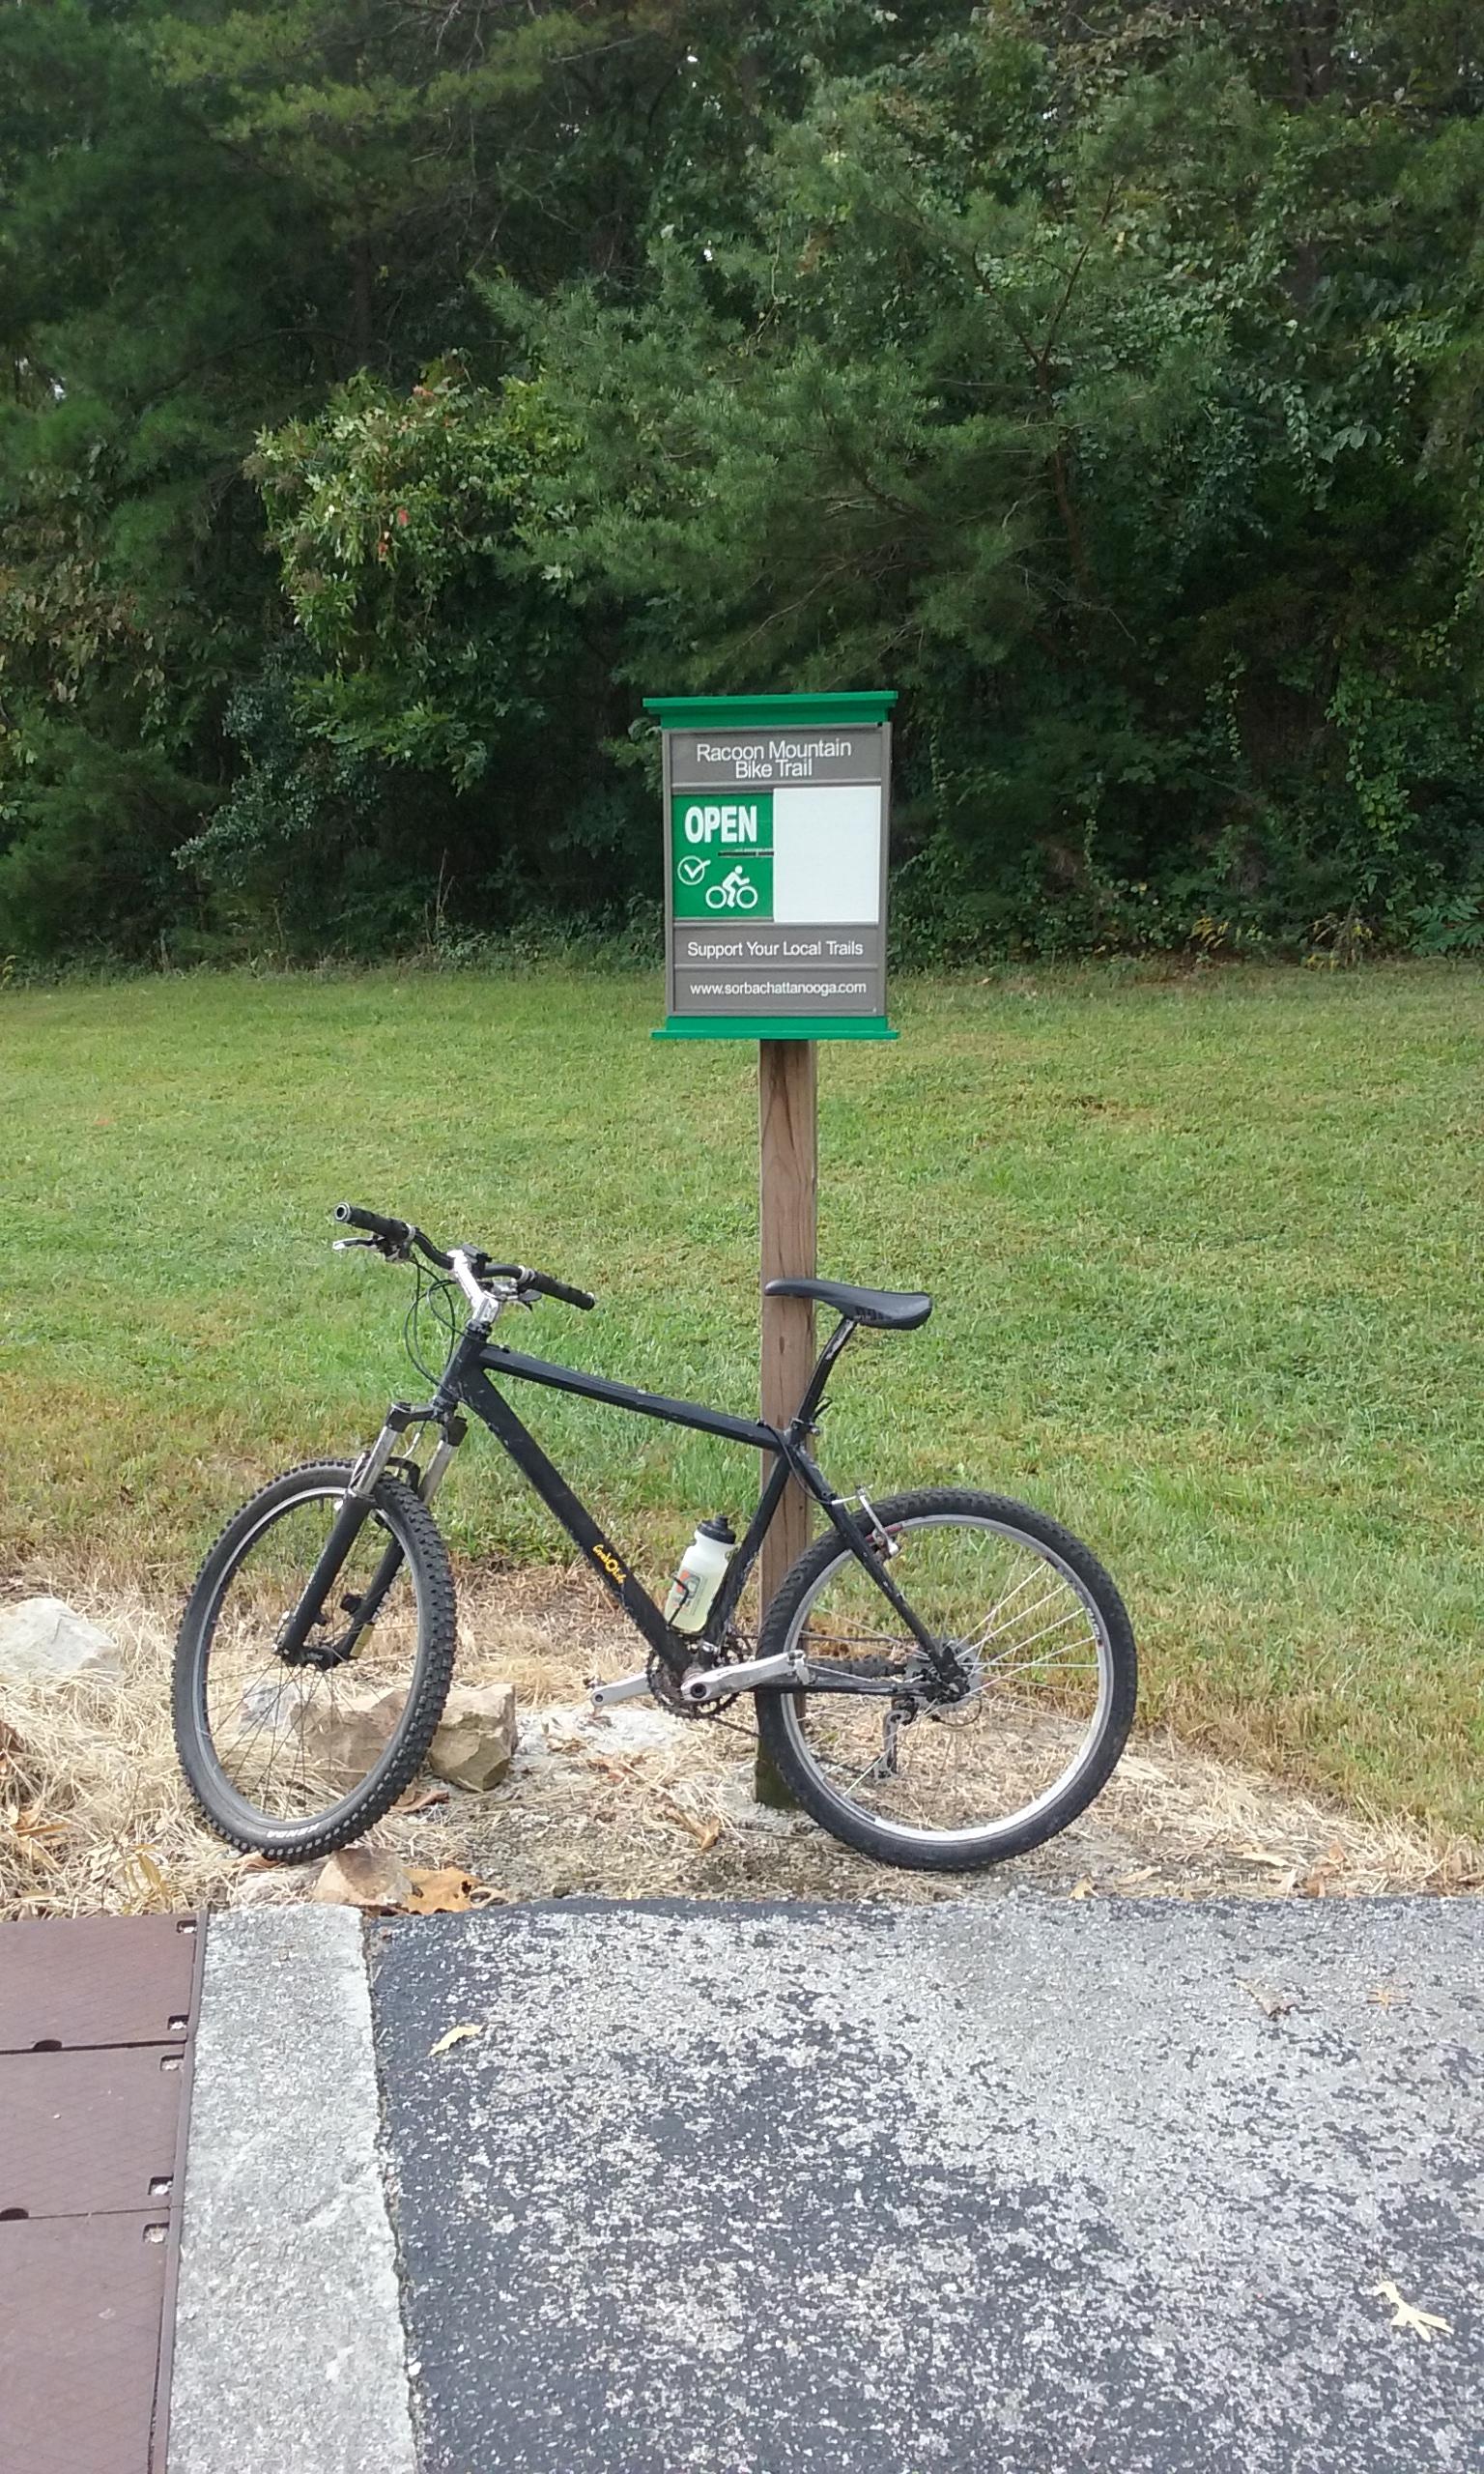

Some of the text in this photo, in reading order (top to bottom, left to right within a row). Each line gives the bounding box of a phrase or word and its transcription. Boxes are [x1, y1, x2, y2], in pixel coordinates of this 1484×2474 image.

[697, 738, 851, 762] Racoon Mountain
[735, 758, 813, 779] Bike Trail
[684, 805, 757, 844] OPEN
[687, 940, 864, 960] Support Your Local Trails
[690, 981, 867, 996] www.sorbachattanooga.com
